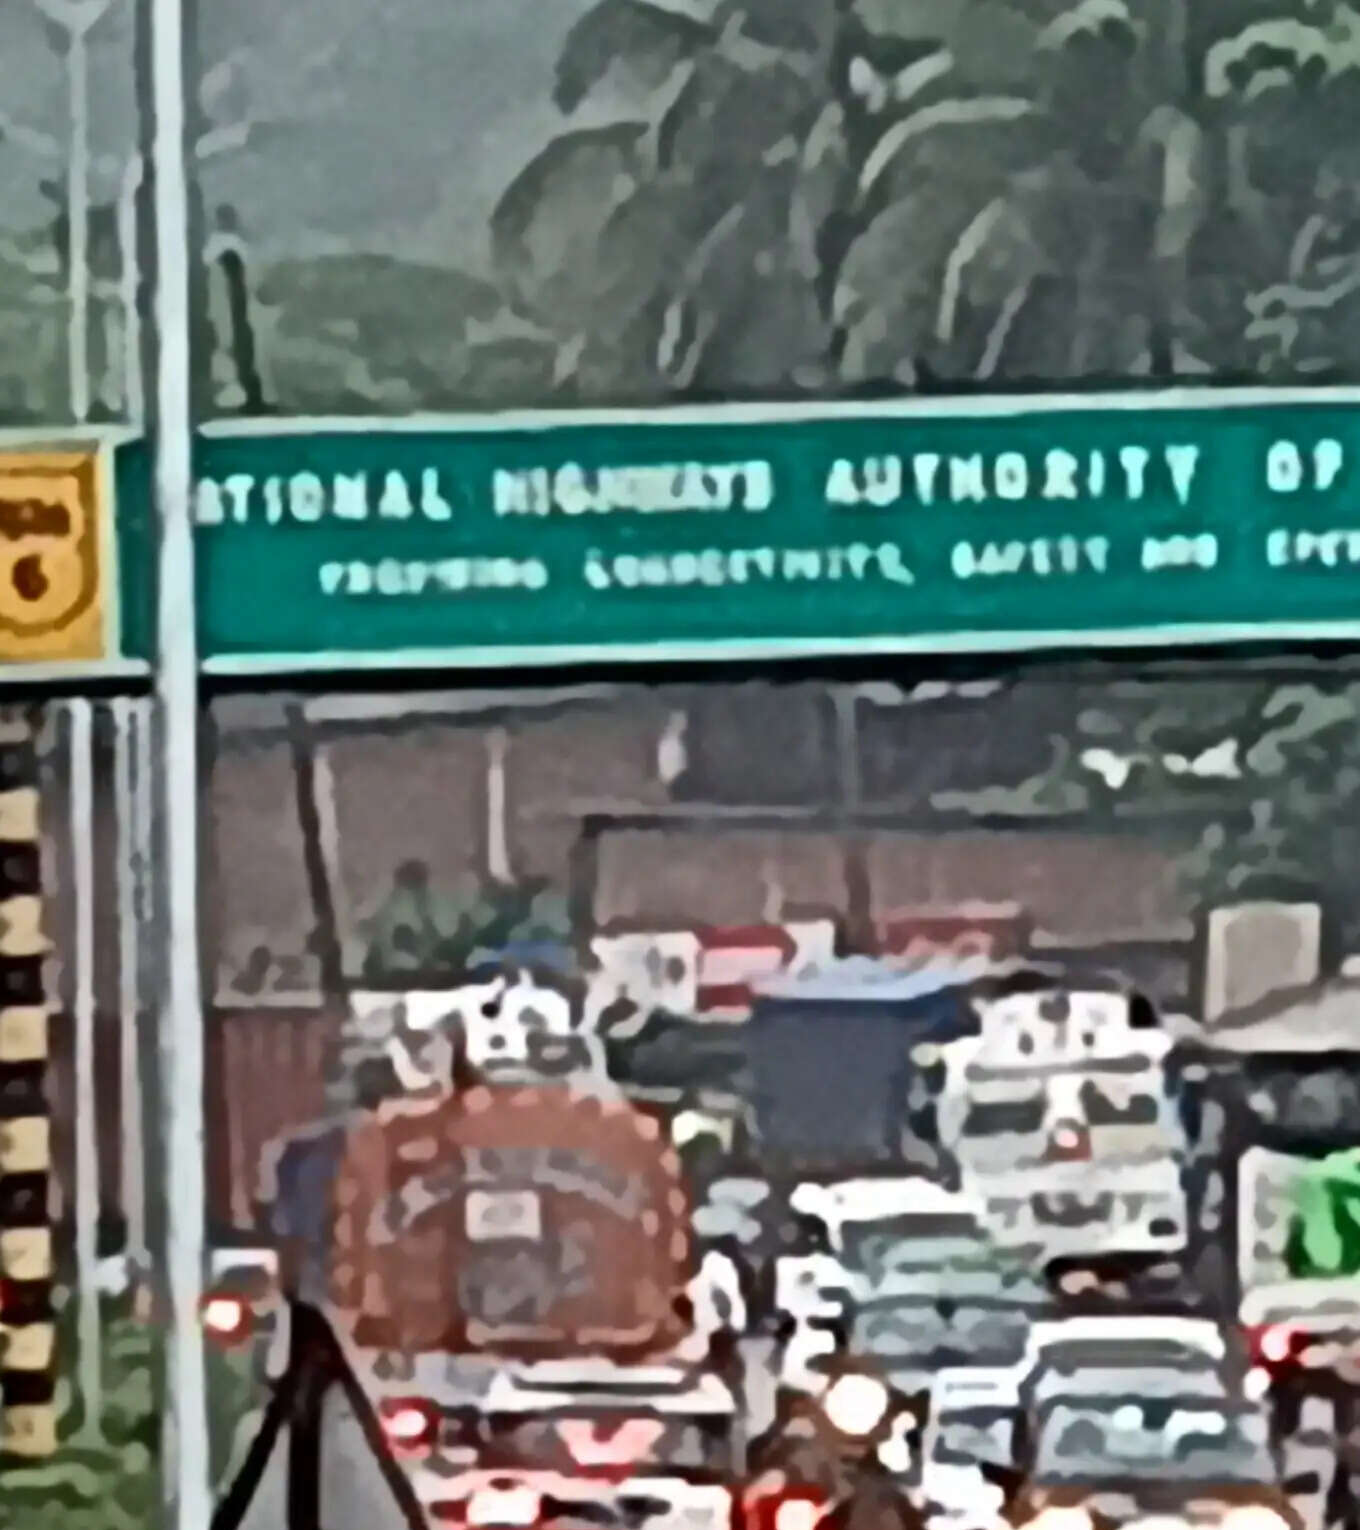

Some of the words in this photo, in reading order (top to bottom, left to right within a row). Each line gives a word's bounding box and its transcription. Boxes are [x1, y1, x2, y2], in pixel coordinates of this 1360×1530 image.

[193, 468, 452, 525] ATIONAL
[825, 445, 1199, 505] AUTHORITY
[1266, 439, 1343, 492] OF
